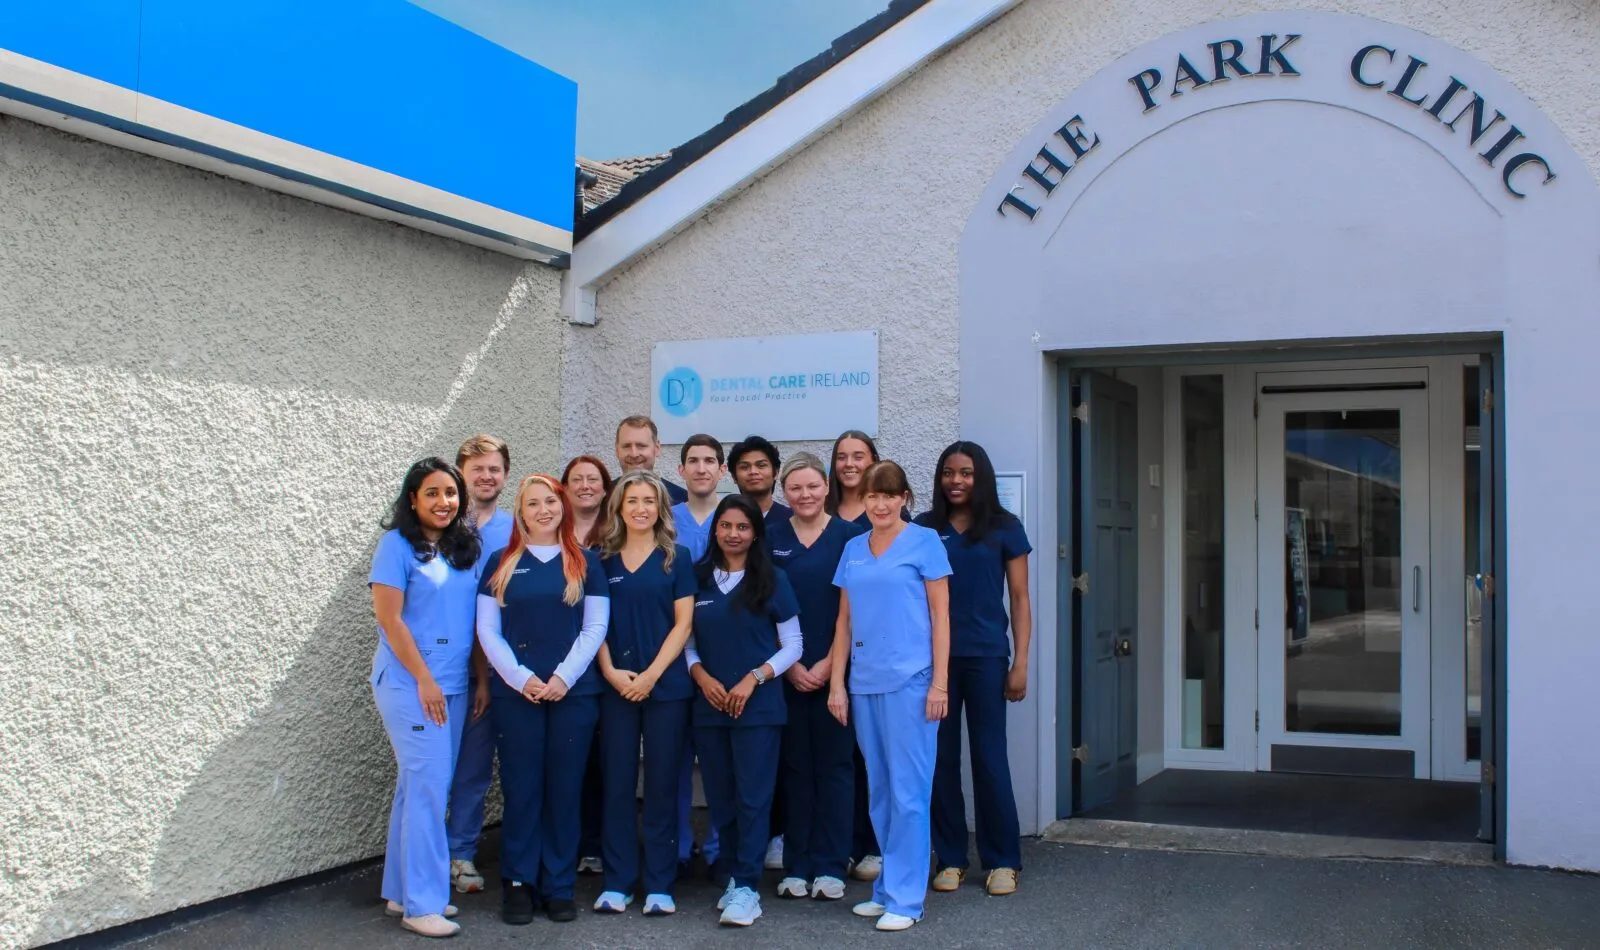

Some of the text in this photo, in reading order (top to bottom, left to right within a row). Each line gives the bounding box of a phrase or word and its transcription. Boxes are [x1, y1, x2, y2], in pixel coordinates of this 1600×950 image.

[997, 33, 1558, 223] THE PARK CLINIC
[710, 371, 870, 392] DENTAL CARE IRELAND
[710, 391, 808, 402] Your Local Practice
